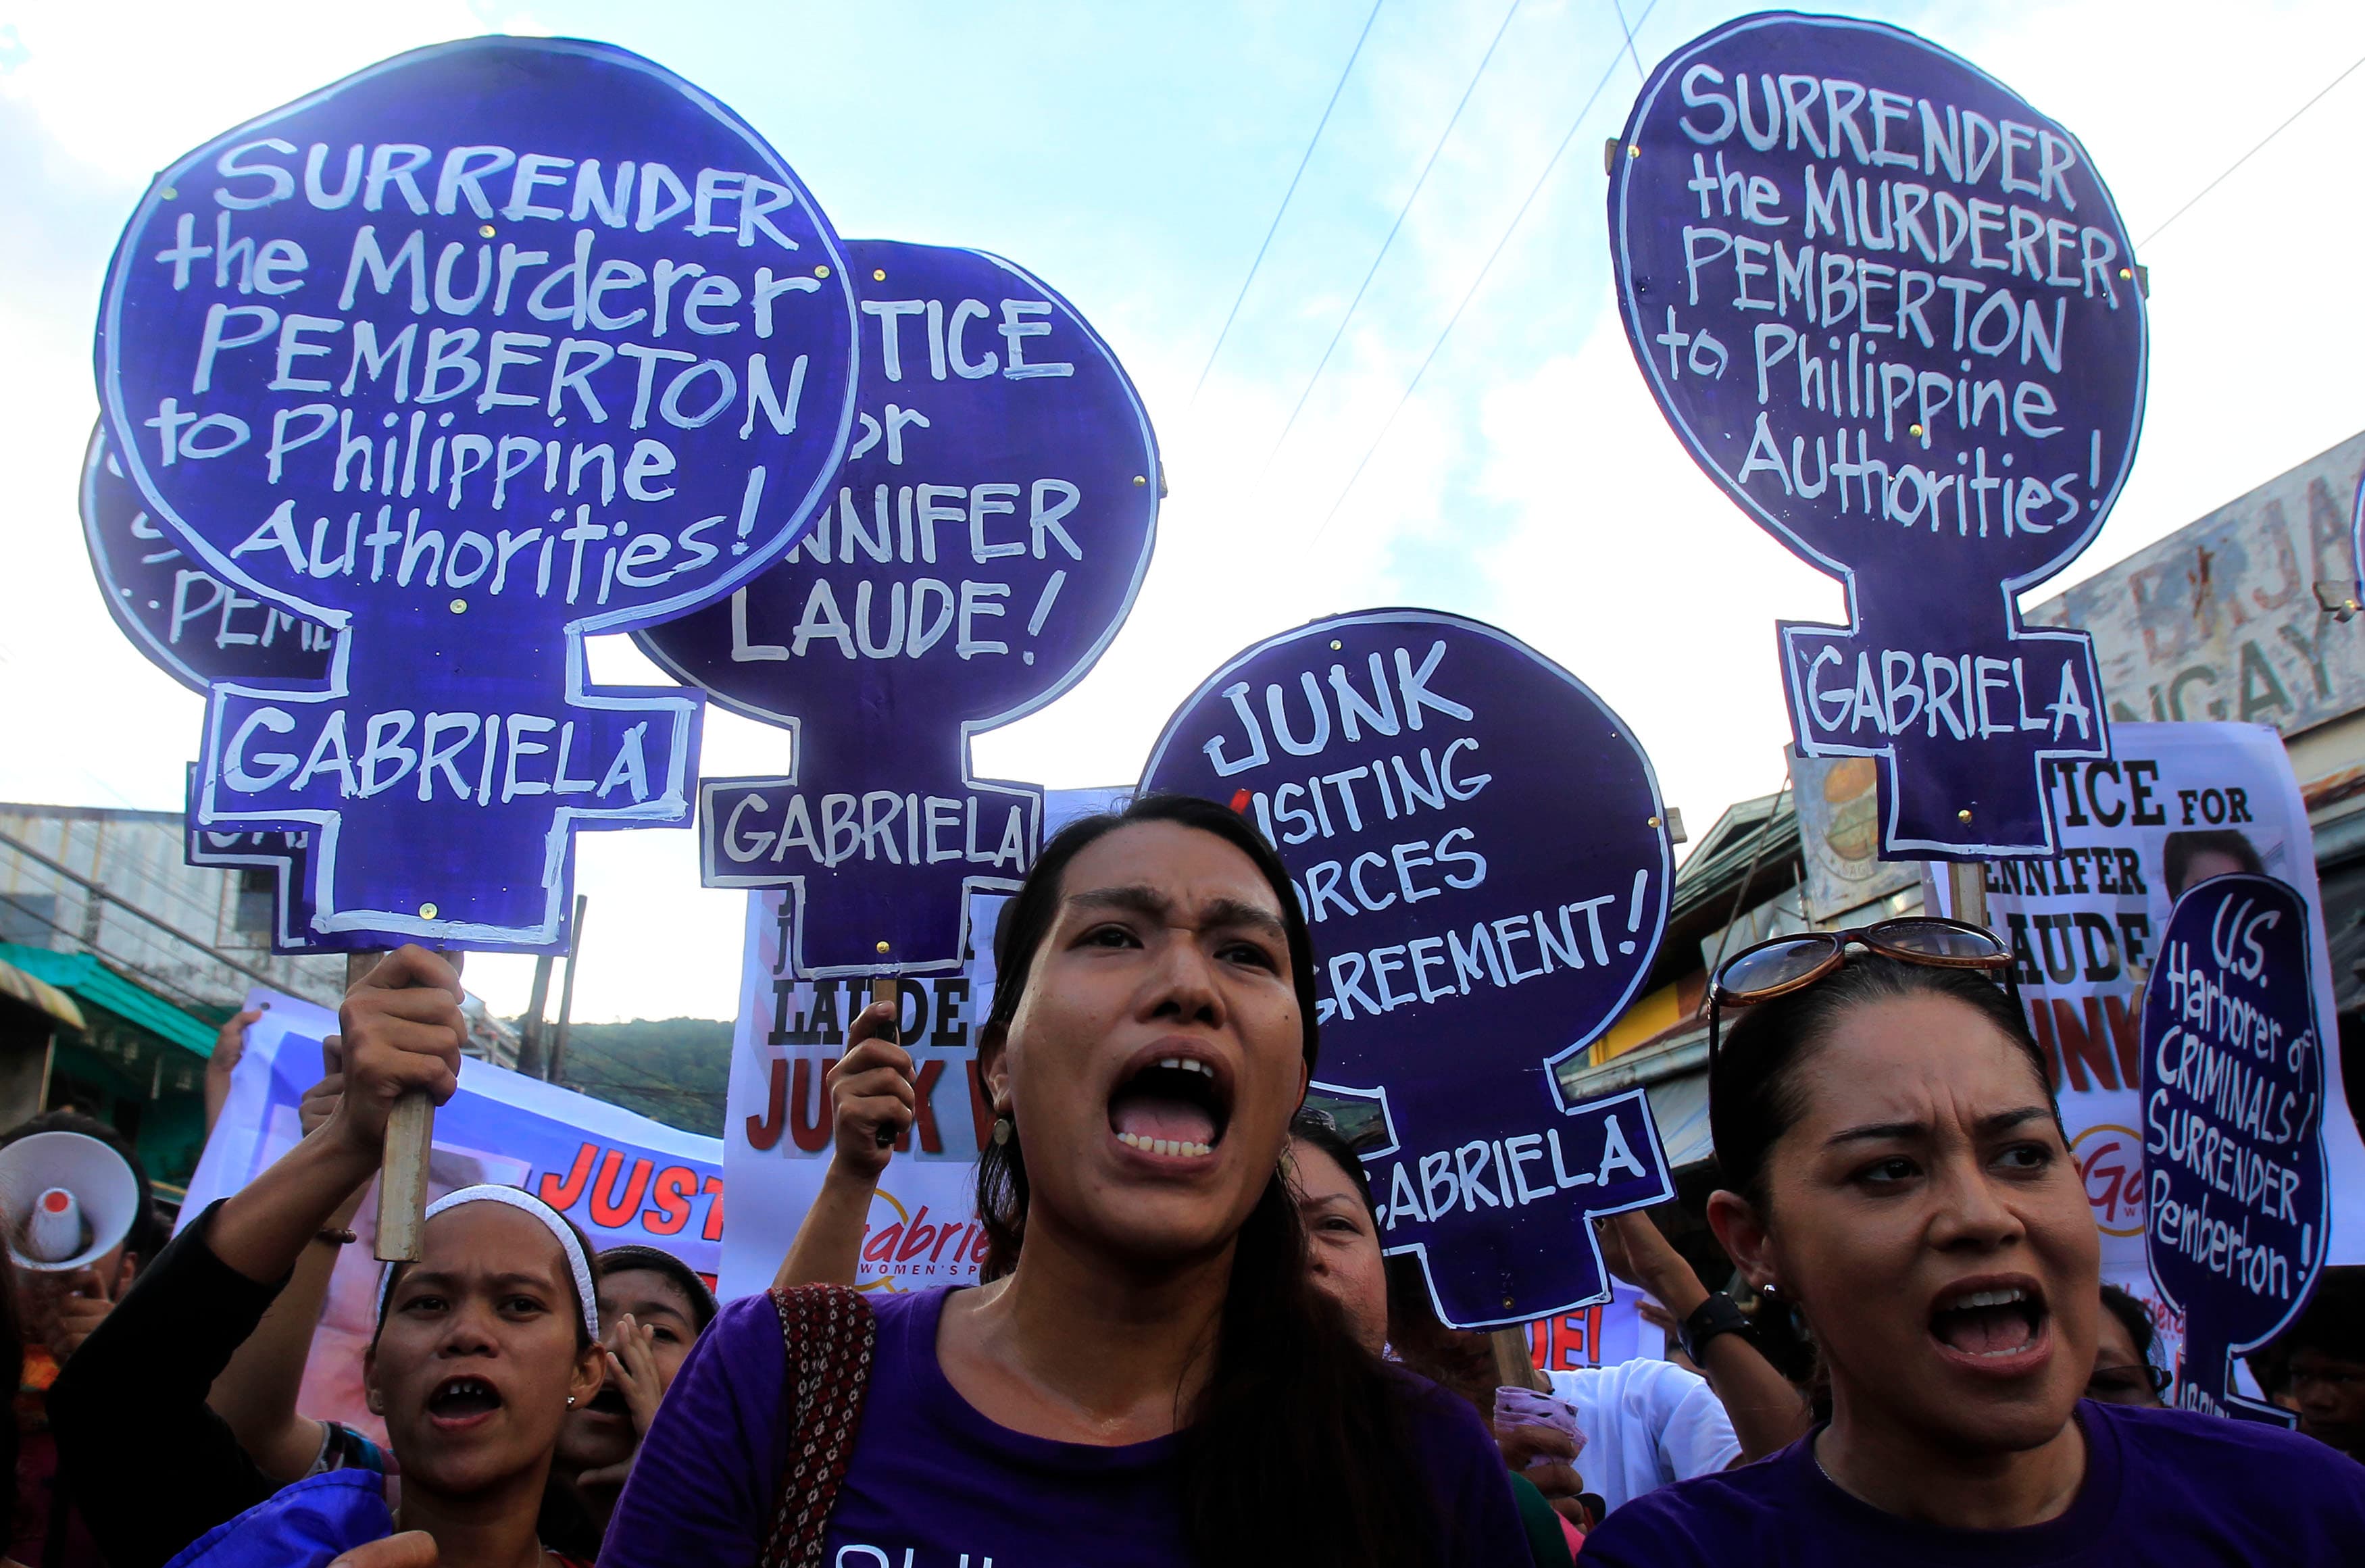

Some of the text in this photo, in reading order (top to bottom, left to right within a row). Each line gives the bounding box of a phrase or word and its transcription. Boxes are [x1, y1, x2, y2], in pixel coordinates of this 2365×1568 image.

[214, 138, 799, 250] SURRENDER
[1678, 64, 2077, 212] SURRENDER
[155, 211, 822, 338] the Murderer
[1688, 151, 2118, 309] the MURDERER
[1683, 225, 2066, 374] PEMBERTON
[193, 303, 807, 438] PEMBERTON
[1657, 305, 2064, 449] to Philippine
[143, 397, 677, 509] to Philippine
[1739, 411, 2102, 537] Authorities!
[230, 465, 766, 604] Authorities!
[731, 570, 1066, 665] LAUDE!
[1202, 640, 1474, 778] JUNK
[1806, 645, 2091, 742] GABRIELA
[223, 707, 649, 807] GABRIELA
[1229, 737, 1492, 853] ISITING
[2050, 760, 2253, 828] ICE FOR
[724, 790, 1025, 873] GABRIELA
[1987, 911, 2156, 985] AUDE
[2212, 893, 2281, 988] U.S.
[2167, 940, 2312, 1093] Harborer of
[746, 1059, 945, 1151] JUK
[2156, 1026, 2315, 1161] CRIMINALS!
[1363, 1114, 1646, 1231] ABRIELA
[2147, 1088, 2299, 1226] SURRENDER
[860, 1264, 957, 1275] WOMEN'S
[2149, 1169, 2312, 1299] Pemberton!
